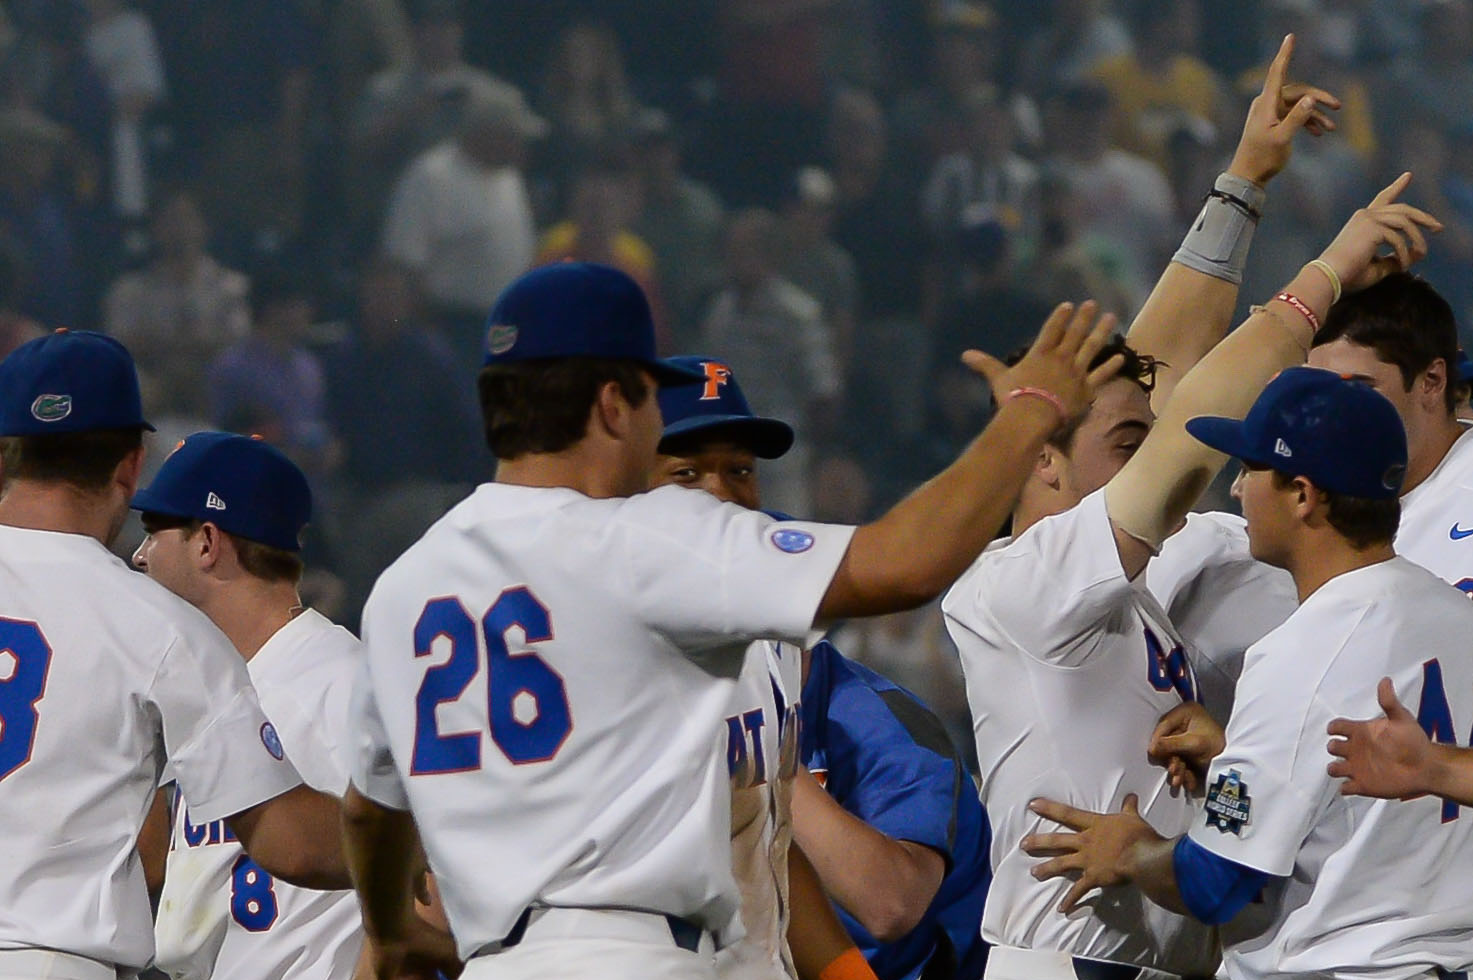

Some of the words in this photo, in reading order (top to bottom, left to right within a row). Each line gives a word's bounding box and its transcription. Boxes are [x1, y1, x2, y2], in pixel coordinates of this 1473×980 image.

[699, 362, 731, 400] F
[410, 585, 574, 777] 26
[231, 853, 281, 933] 8
